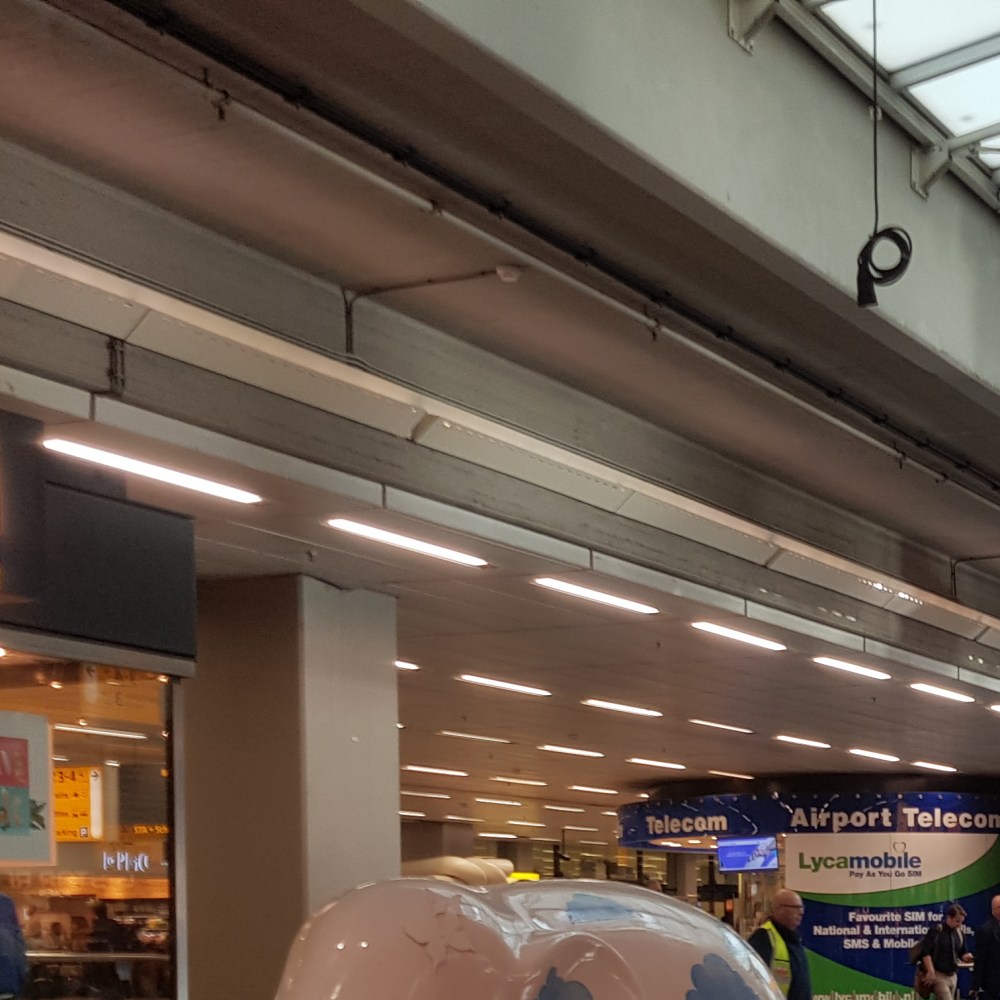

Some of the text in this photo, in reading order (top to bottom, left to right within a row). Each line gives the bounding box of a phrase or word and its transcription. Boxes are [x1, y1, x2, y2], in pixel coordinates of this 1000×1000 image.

[646, 816, 728, 835] Telecom
[791, 808, 892, 833] Airport
[798, 851, 922, 873] Lycamobile
[849, 871, 863, 879] Pay
[848, 911, 944, 922] Favourite SIM for
[813, 925, 860, 936] National
[863, 925, 872, 935] &
[843, 938, 870, 949] SMS
[872, 938, 881, 949] &
